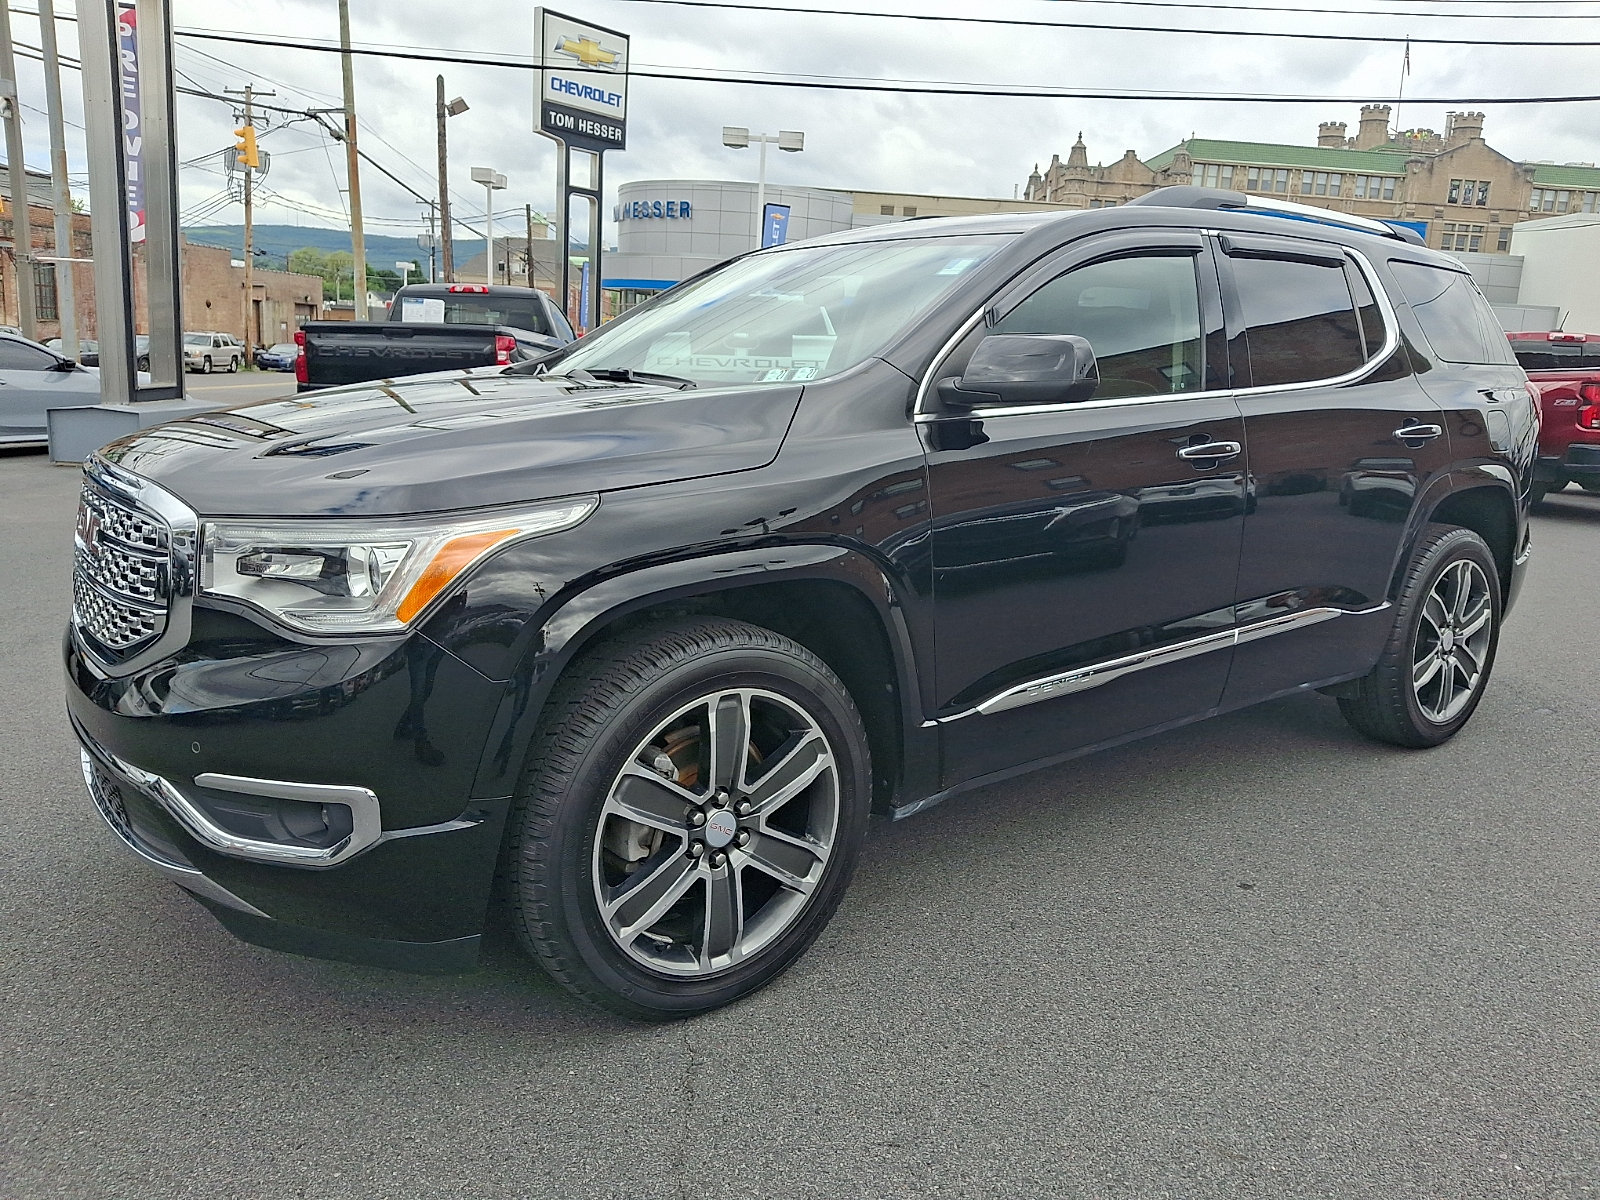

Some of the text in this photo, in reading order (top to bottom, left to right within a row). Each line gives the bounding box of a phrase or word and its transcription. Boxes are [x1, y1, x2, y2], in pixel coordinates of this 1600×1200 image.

[551, 77, 622, 107] CHEVROLET
[549, 111, 622, 141] TOM HESSER
[317, 345, 478, 360] CHEVROLET
[656, 356, 825, 370] CHEVROLET
[1026, 671, 1094, 697] DENALI
[710, 822, 733, 836] GMC
